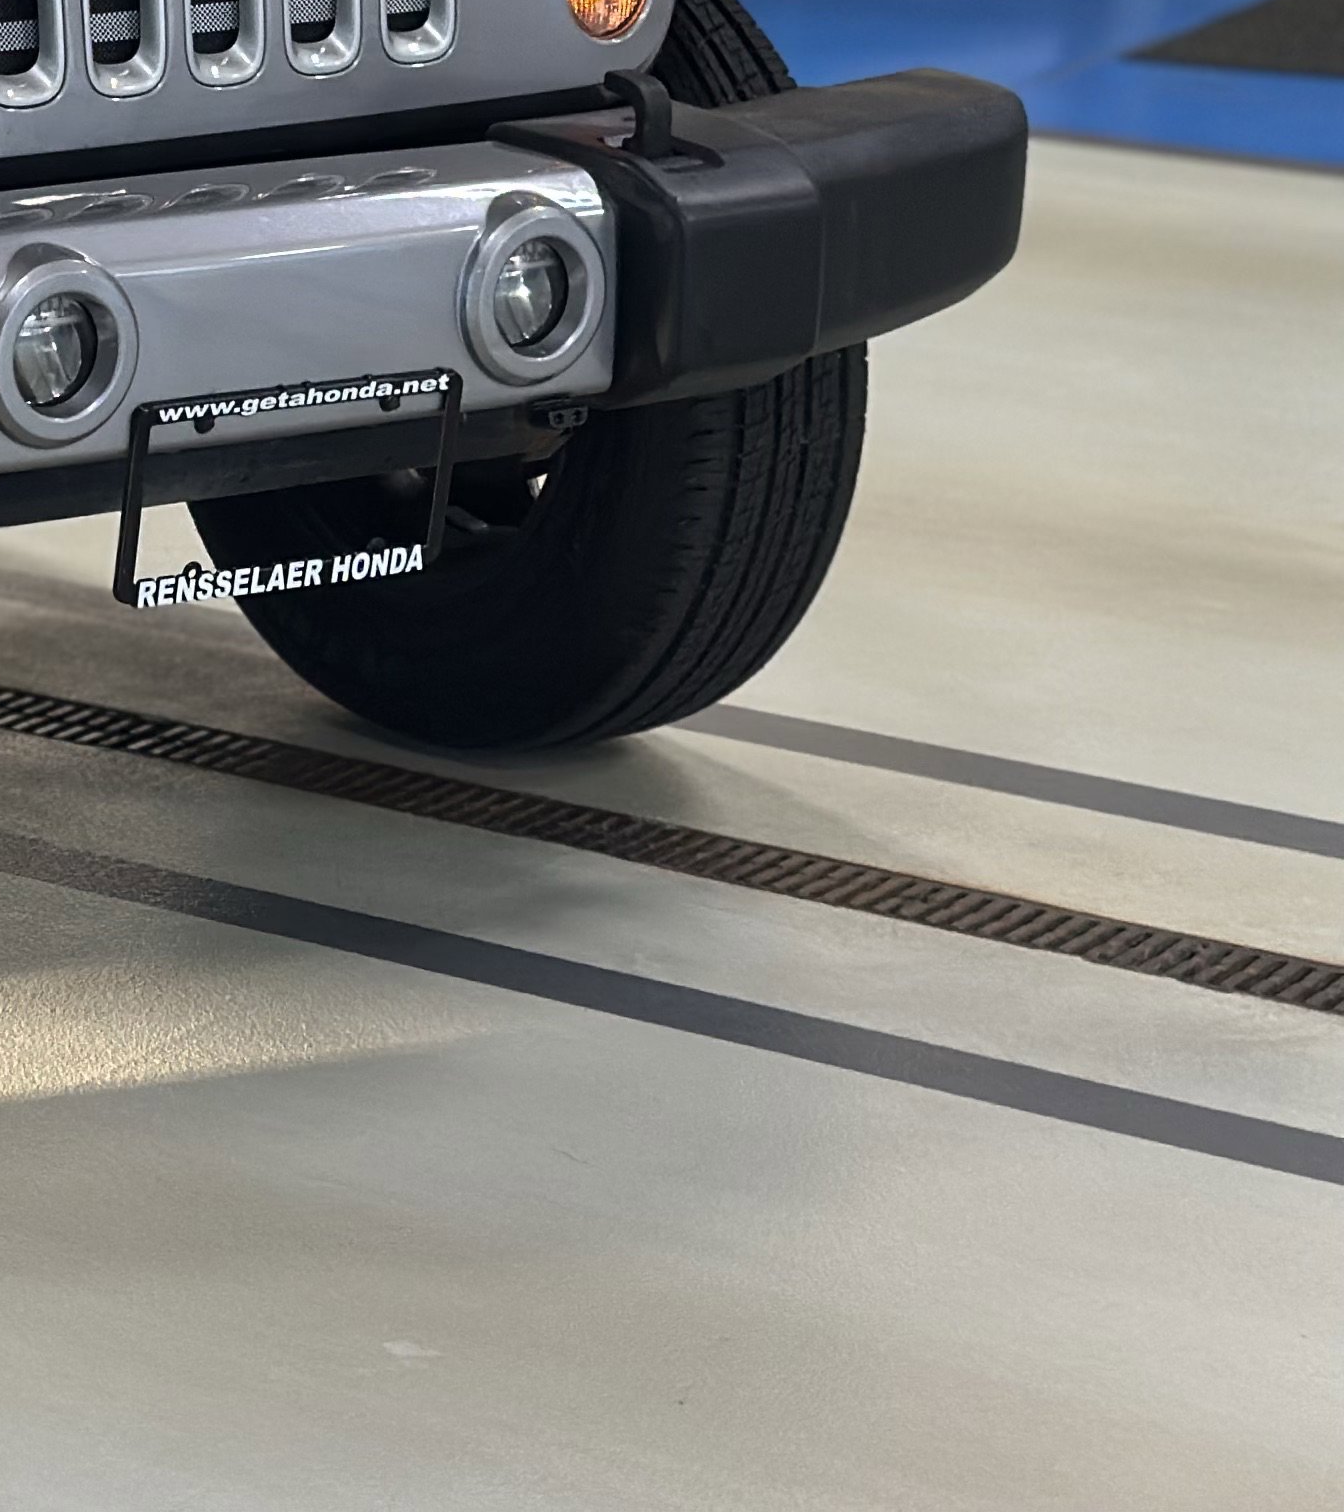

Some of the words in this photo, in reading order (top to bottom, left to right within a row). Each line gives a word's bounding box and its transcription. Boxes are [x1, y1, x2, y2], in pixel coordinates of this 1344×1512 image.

[159, 374, 450, 423] www.getahonda.net
[137, 559, 323, 609] RENSSELAER
[330, 544, 424, 584] HONDA
